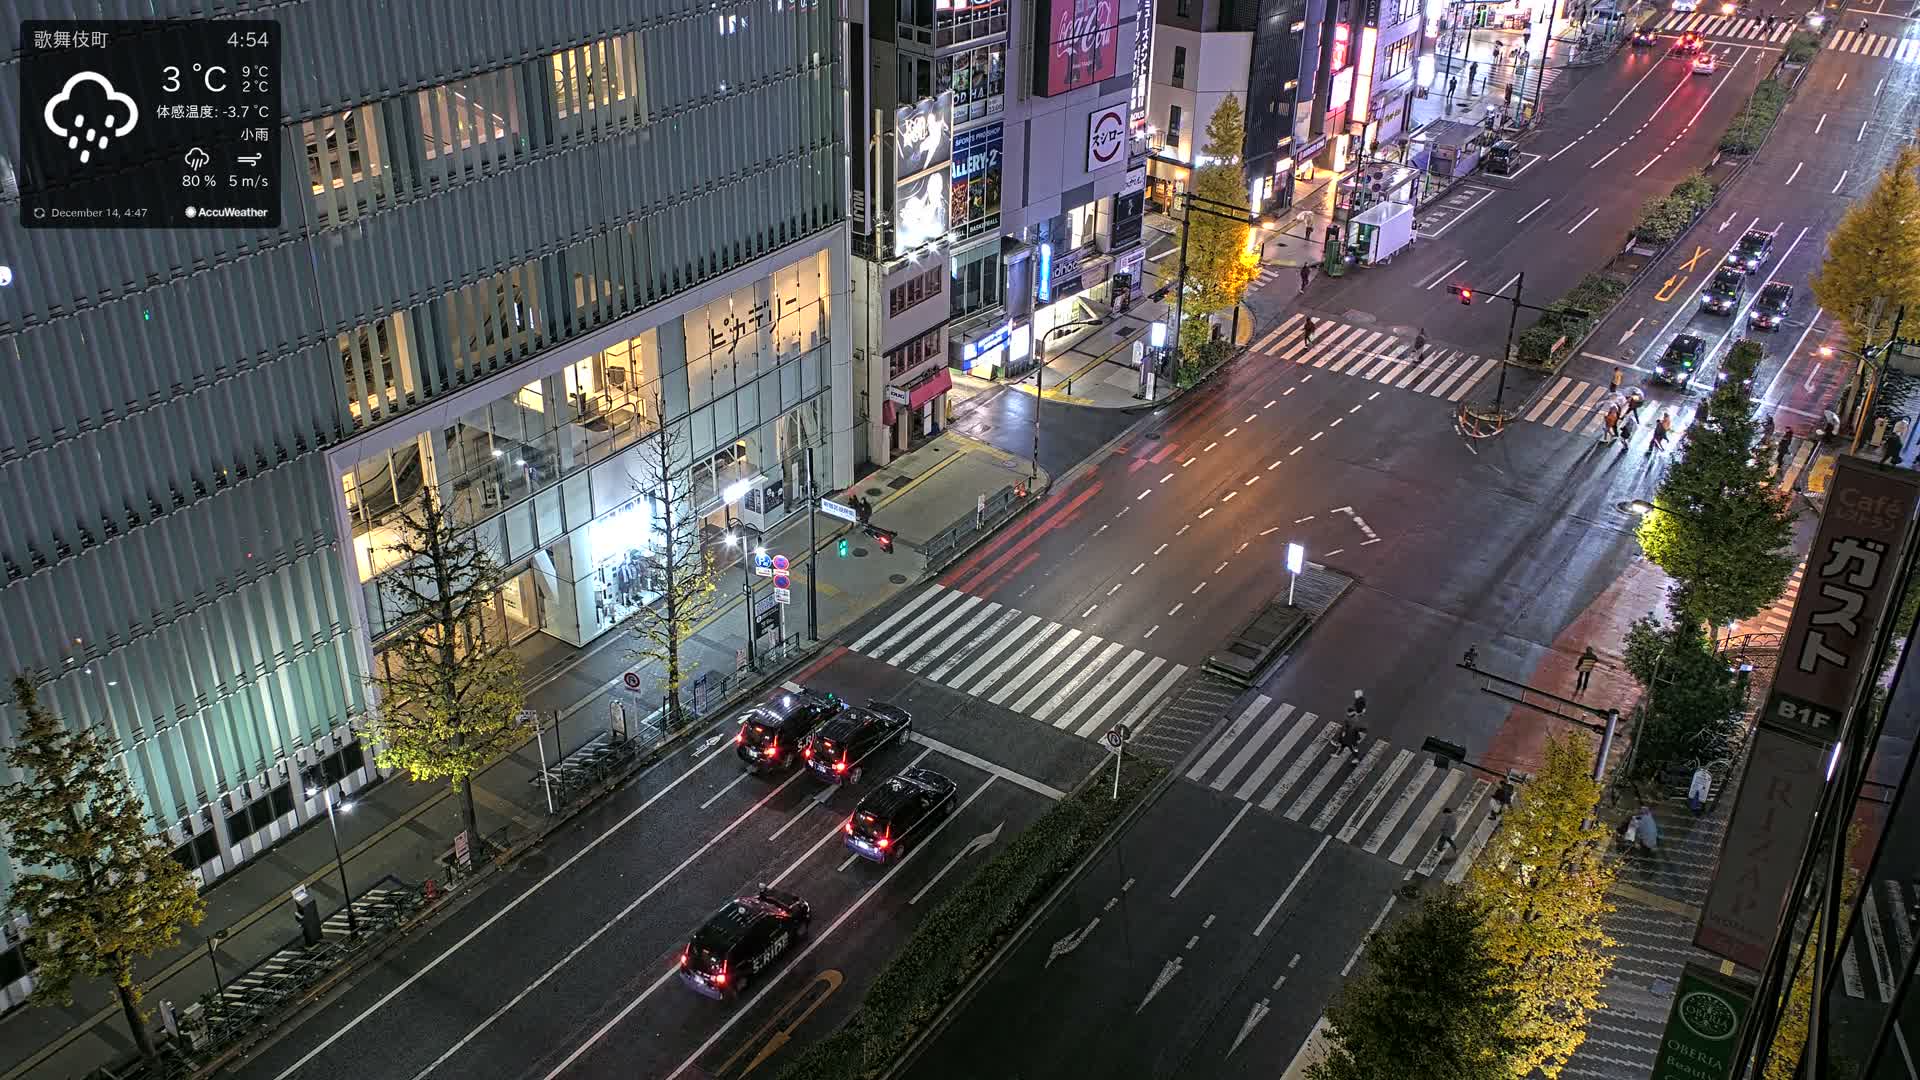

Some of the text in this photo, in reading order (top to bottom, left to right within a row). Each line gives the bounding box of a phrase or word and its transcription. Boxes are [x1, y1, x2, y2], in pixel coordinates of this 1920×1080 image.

[1091, 129, 1124, 149] スシロー
[853, 190, 865, 223] MUJI
[711, 298, 797, 355] ピカデリー
[1799, 536, 1885, 673] ガスト
[1777, 700, 1832, 729] B1F
